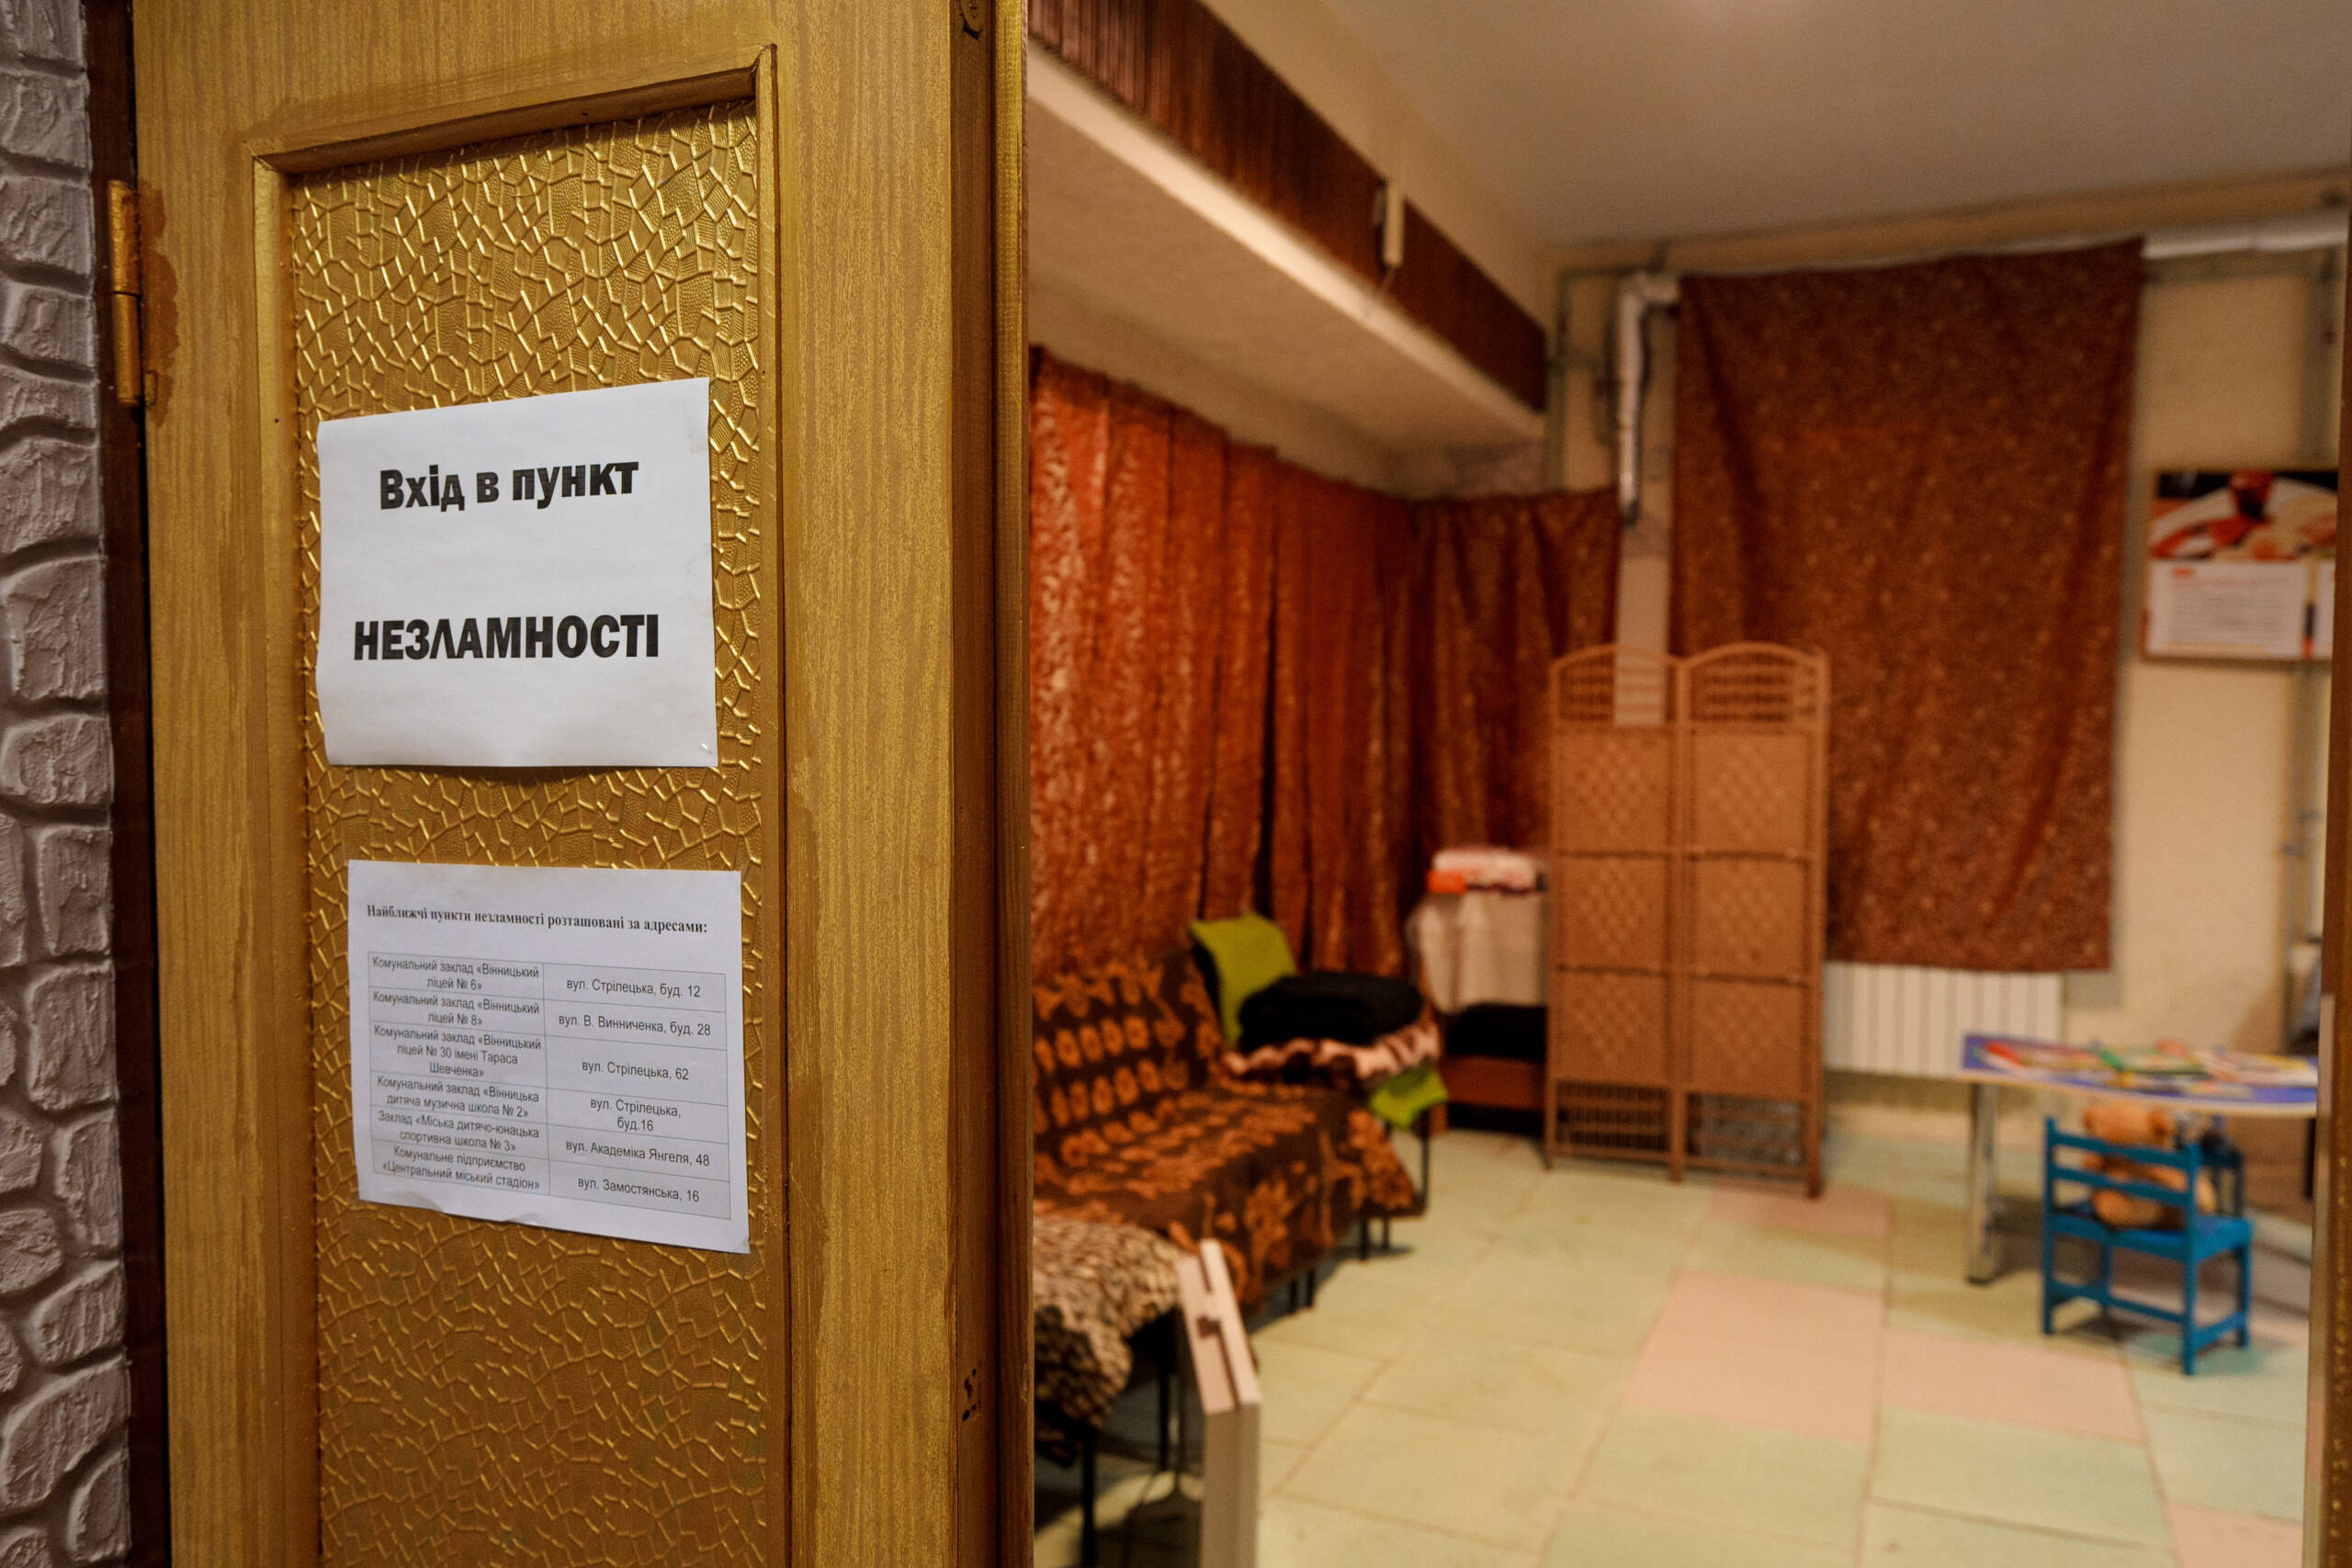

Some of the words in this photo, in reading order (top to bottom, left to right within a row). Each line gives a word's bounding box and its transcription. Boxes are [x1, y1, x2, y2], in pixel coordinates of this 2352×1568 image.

[380, 465, 465, 512] Вхід
[476, 472, 499, 502] в
[513, 461, 639, 509] пункт
[354, 614, 659, 660] НЕЗЛАМНОСТІ
[368, 905, 427, 919] Найближчі
[431, 910, 470, 922] пункти
[475, 912, 544, 925] незламності
[548, 917, 624, 929] розташовані
[628, 919, 639, 930] за
[644, 921, 707, 934] адресами:
[373, 956, 437, 971] Комунальний
[440, 964, 473, 975] заклад
[477, 964, 538, 978] «Вінницький
[427, 977, 453, 989] ліцей
[457, 978, 467, 988] №
[471, 979, 482, 990] 6»
[567, 980, 588, 991] вул.
[593, 979, 656, 995] Стрілецька,
[660, 984, 683, 998] буд.
[688, 986, 700, 997] 12
[374, 991, 437, 1007] Комунальний
[441, 999, 474, 1010] заклад
[478, 998, 539, 1013] «Вінницький
[428, 1012, 454, 1023] ліцей
[458, 1014, 468, 1023] №
[471, 1015, 482, 1025] 8»
[560, 1015, 580, 1026] вул.
[584, 1015, 594, 1026] В.
[599, 1016, 666, 1033] Винниченка,
[670, 1021, 693, 1036] буд.
[697, 1024, 710, 1035] 28
[374, 1025, 438, 1040] Комунальний
[442, 1033, 475, 1044] заклад
[479, 1034, 541, 1049] «Вінницький
[397, 1043, 423, 1055] ліцей
[426, 1046, 437, 1055] №
[441, 1046, 452, 1057] 30
[455, 1050, 478, 1060] імені
[481, 1051, 517, 1065] Тараса
[430, 1062, 484, 1077] Шевченка»
[582, 1061, 603, 1074] вул.
[607, 1062, 672, 1080] Стрілецька,
[676, 1068, 688, 1080] 62
[378, 1076, 443, 1091] Комунальний
[446, 1086, 480, 1097] заклад
[483, 1087, 538, 1102] «Вінницька
[387, 1095, 420, 1107] дитяча
[424, 1099, 465, 1111] музична
[469, 1103, 499, 1114] школа
[503, 1105, 514, 1115] №
[516, 1106, 528, 1117] 2»
[591, 1099, 611, 1111] вул.
[616, 1100, 681, 1117] Стрілецька,
[379, 1111, 412, 1124] Заклад
[416, 1115, 454, 1128] «Міська
[457, 1120, 539, 1138] дитячо-юнацька
[400, 1131, 451, 1145] спортивна
[455, 1137, 486, 1147] школа
[490, 1139, 501, 1149] №
[504, 1141, 515, 1152] 3»
[394, 1146, 453, 1162] Комунальне
[457, 1154, 525, 1171] підприємство
[567, 1141, 587, 1154] вул.
[591, 1143, 645, 1159] Академіка
[649, 1149, 692, 1166] Янгеля,
[696, 1155, 709, 1166] 48
[383, 1162, 452, 1179] «Центральний
[456, 1169, 492, 1184] міський
[496, 1176, 539, 1190] стадіон»
[578, 1179, 599, 1190] вул.
[603, 1179, 682, 1201] Замостянська,
[687, 1190, 699, 1202] 16
